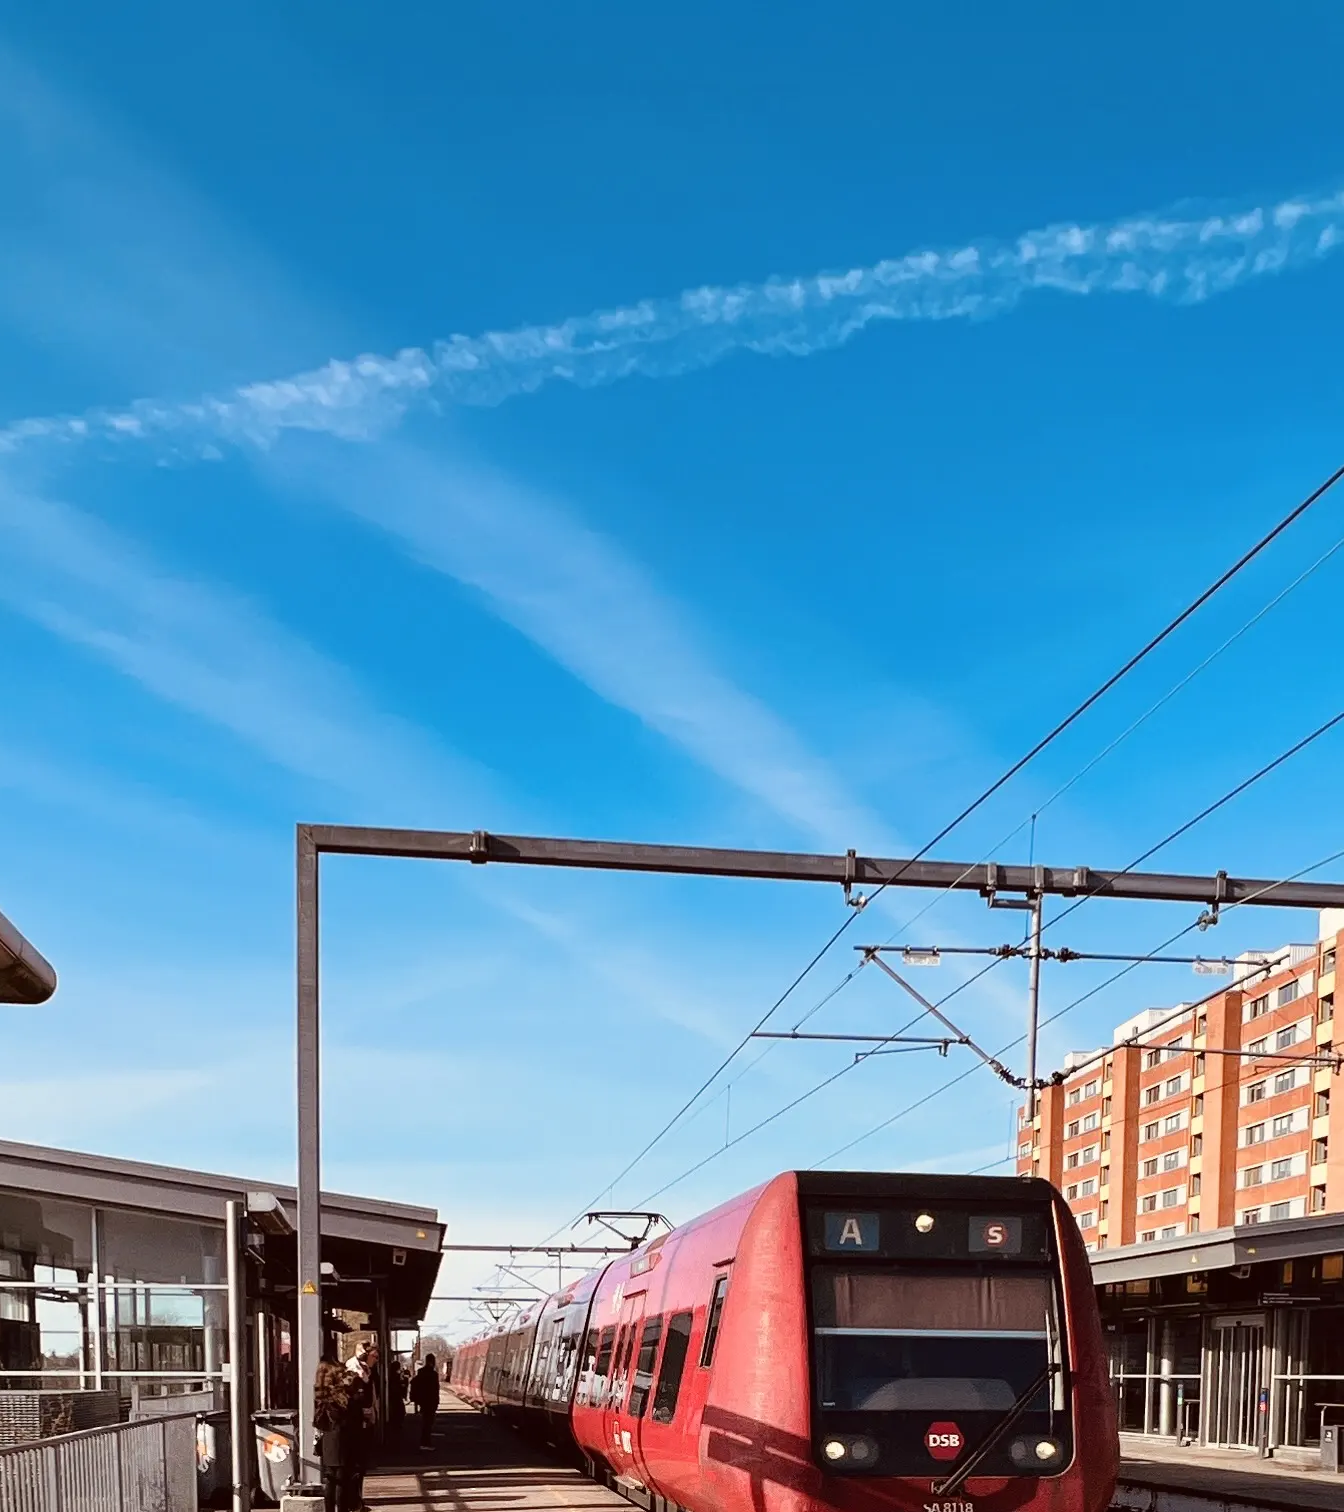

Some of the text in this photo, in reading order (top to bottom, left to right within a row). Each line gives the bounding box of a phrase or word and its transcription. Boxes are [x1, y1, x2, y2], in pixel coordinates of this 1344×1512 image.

[839, 1219, 862, 1245] A
[988, 1226, 1003, 1243] S
[929, 1434, 960, 1447] DSB
